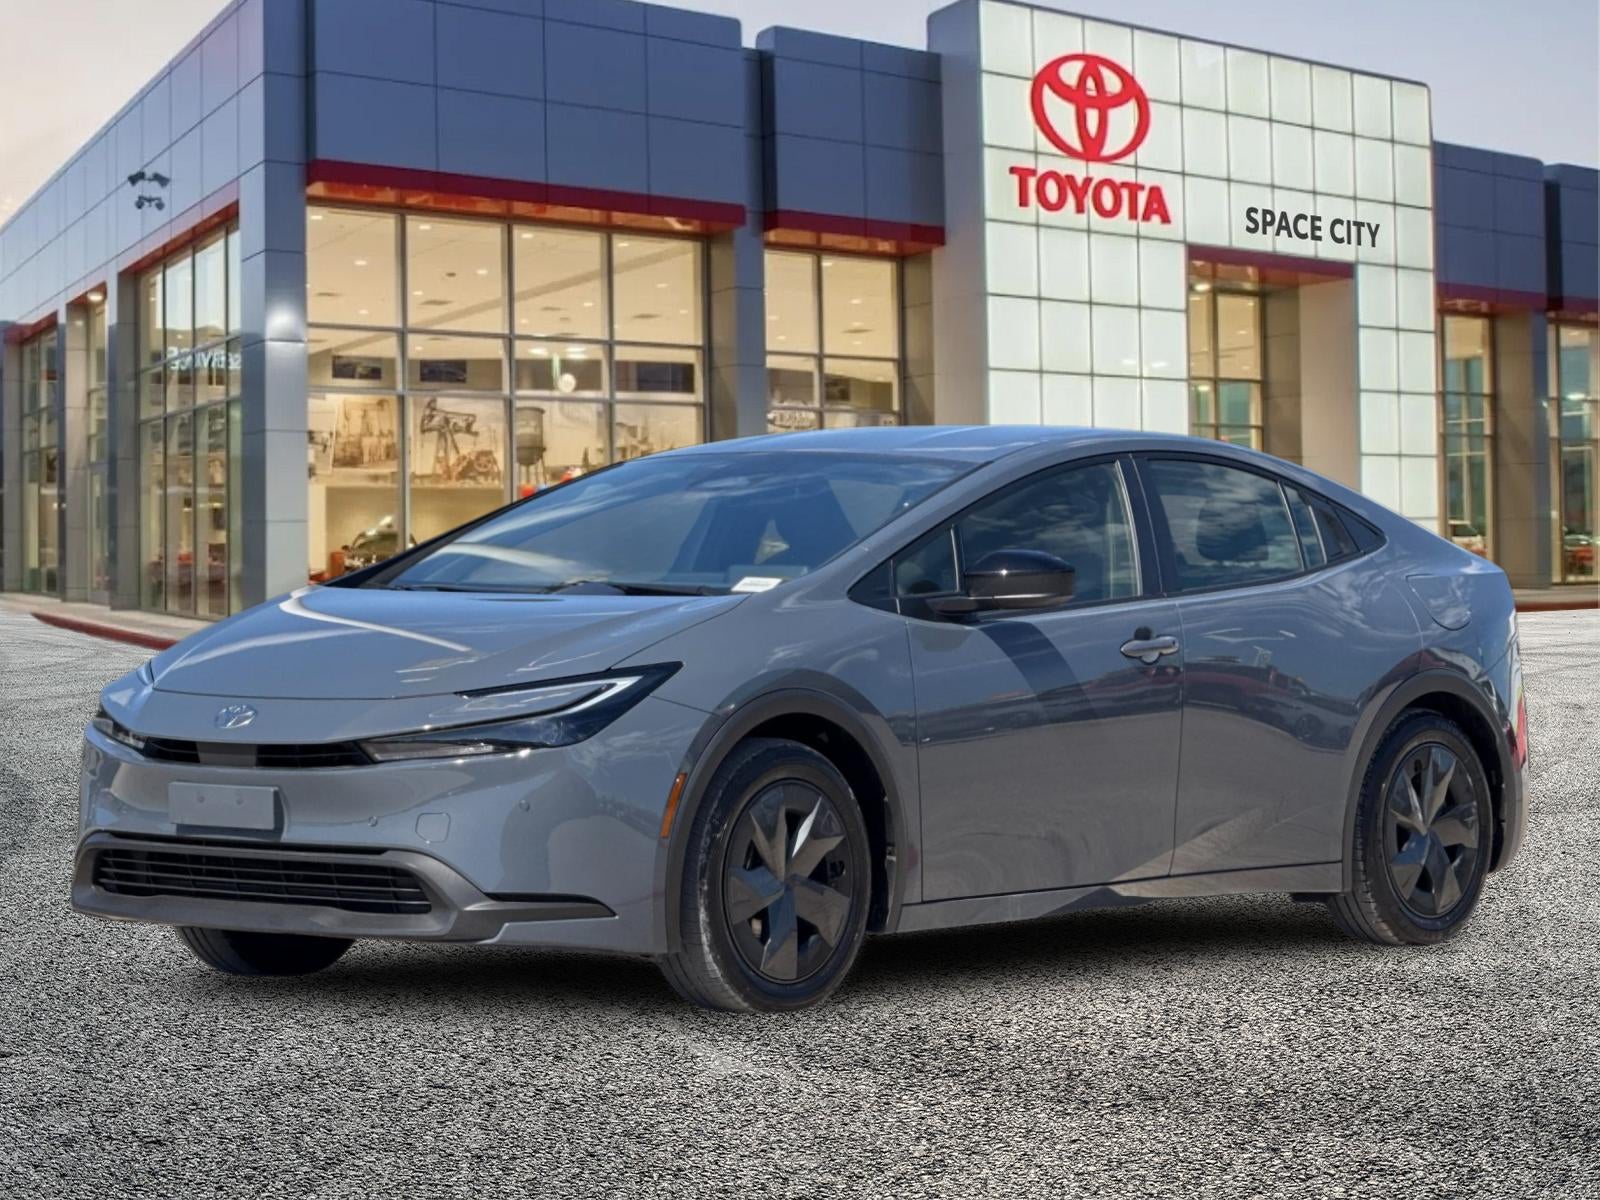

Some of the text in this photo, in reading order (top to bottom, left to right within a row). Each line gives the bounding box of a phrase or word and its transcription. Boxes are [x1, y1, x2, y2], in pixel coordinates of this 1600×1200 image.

[1009, 166, 1171, 224] TOYOTA
[1245, 206, 1380, 248] SPACE CITY
